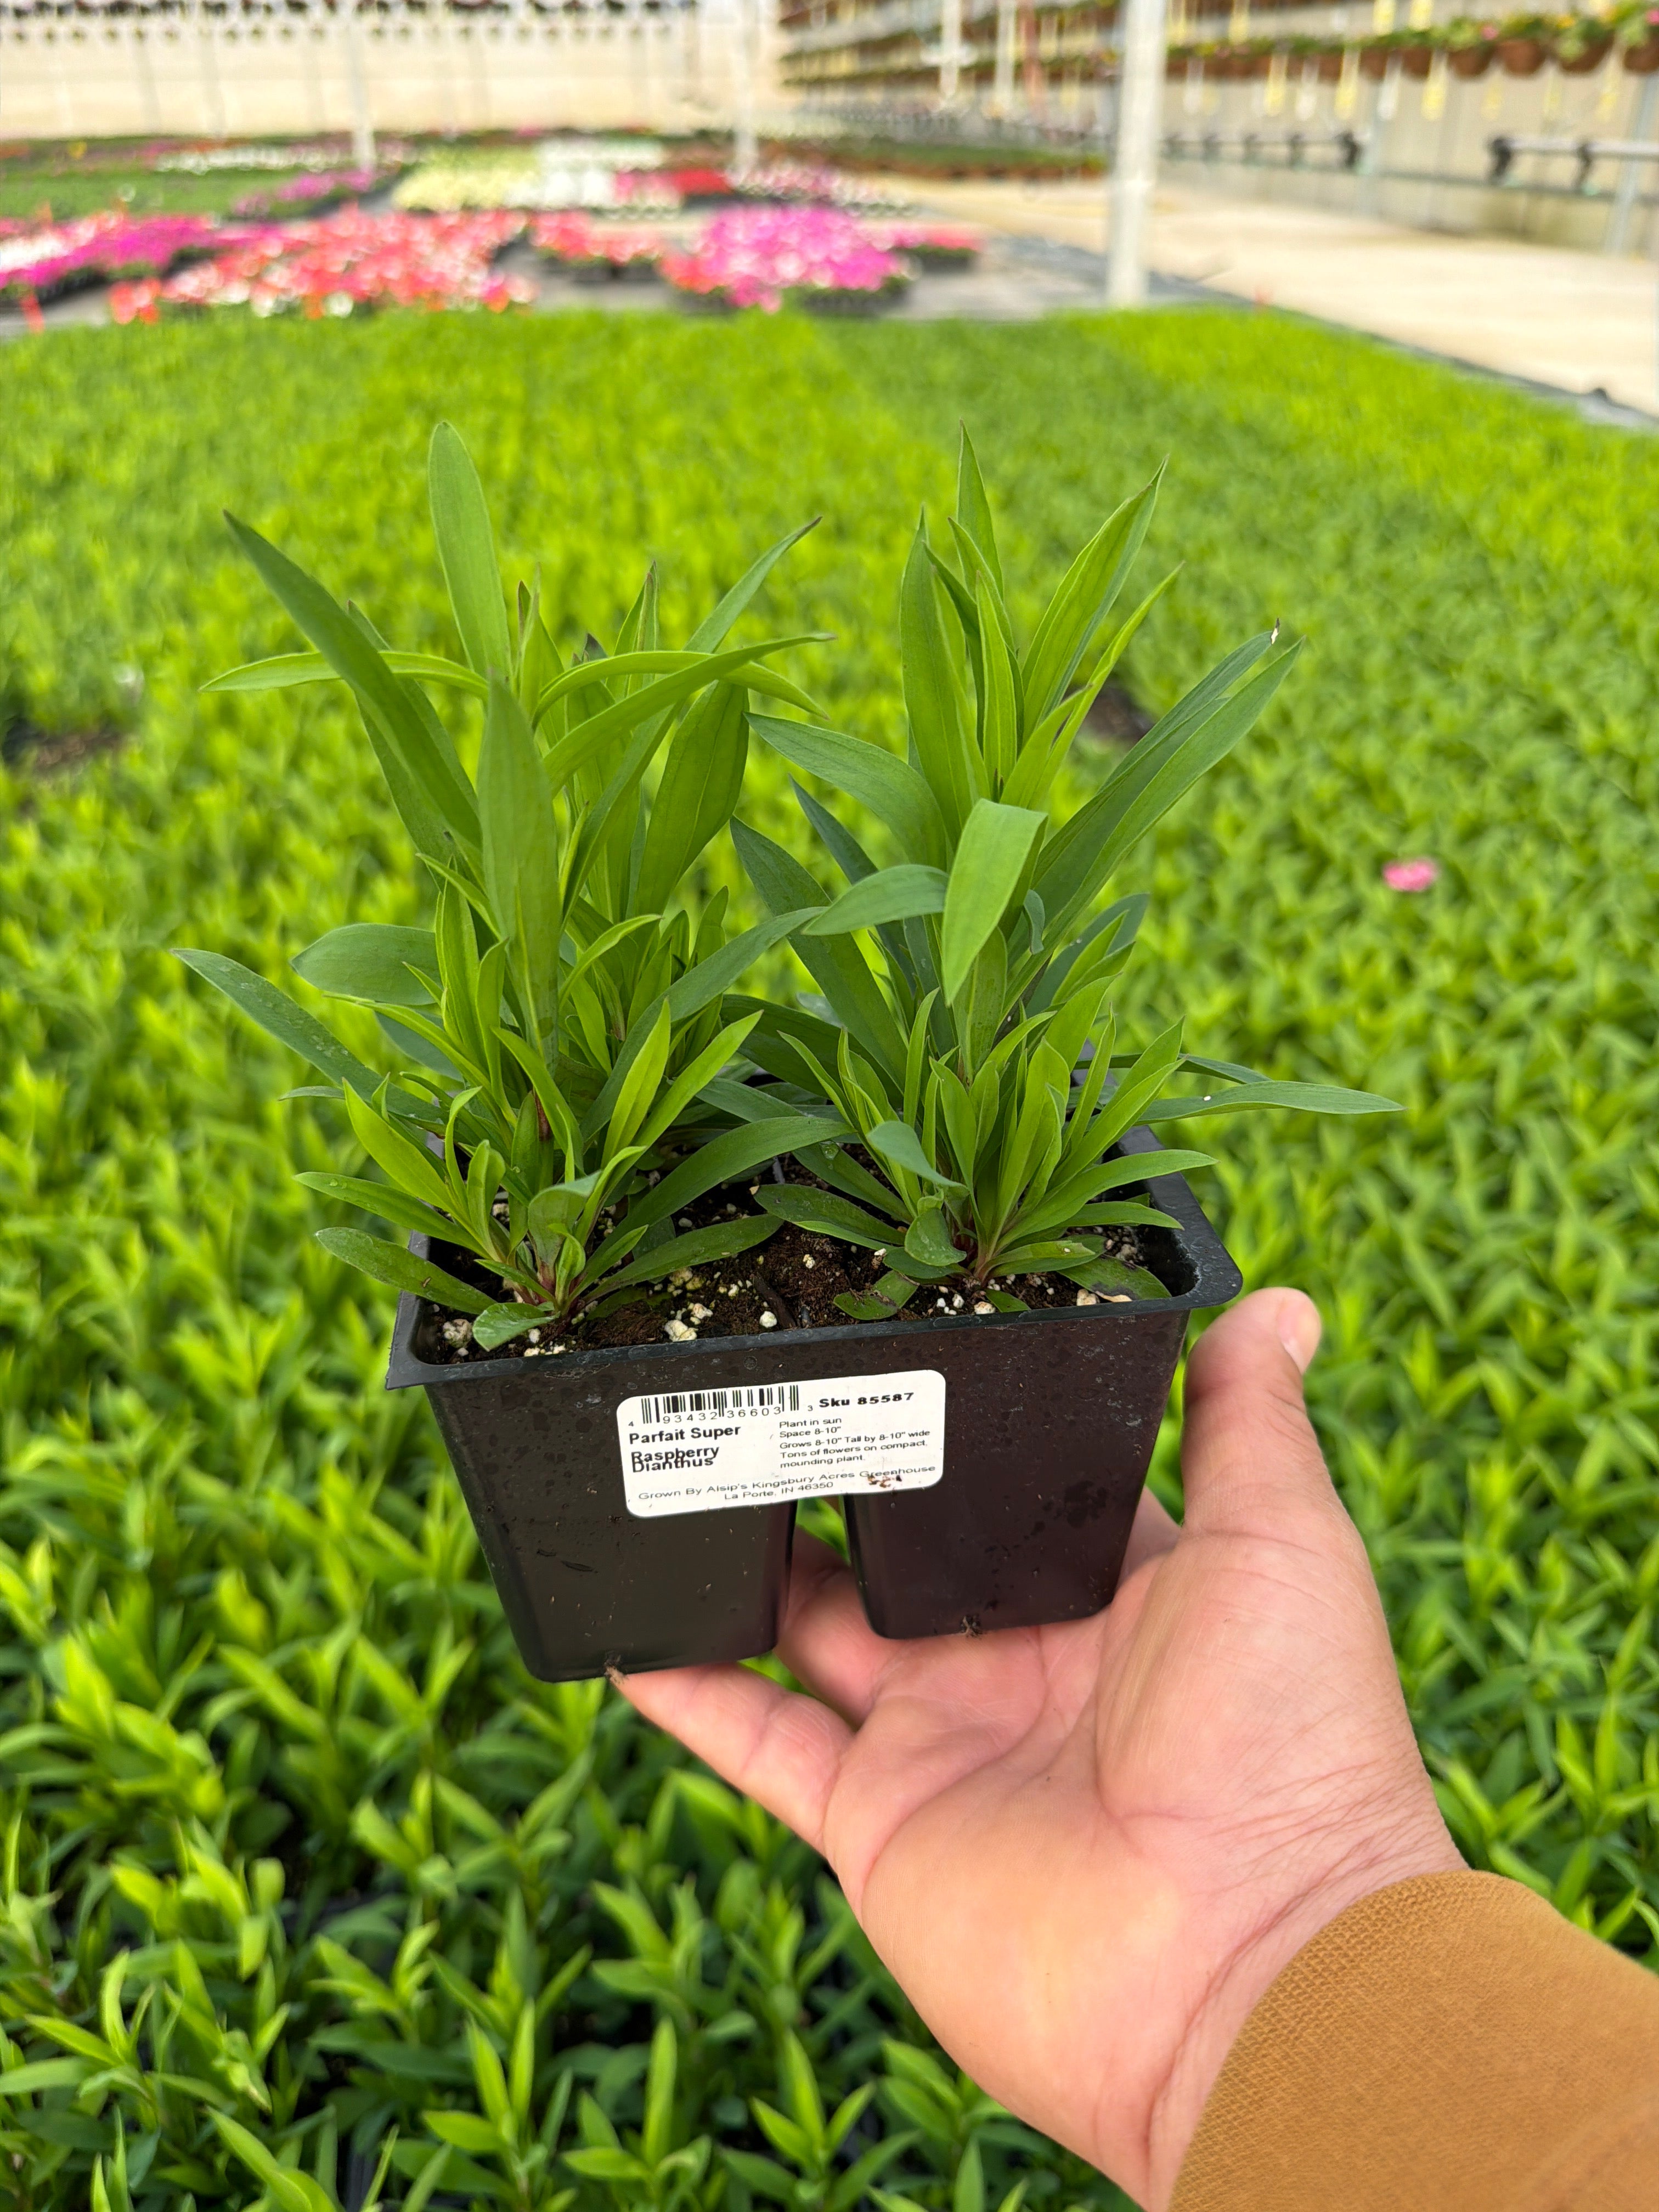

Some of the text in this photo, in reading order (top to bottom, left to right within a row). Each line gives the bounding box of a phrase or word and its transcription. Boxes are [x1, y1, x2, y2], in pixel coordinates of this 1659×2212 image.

[819, 1392, 914, 1408] Sku 85587
[779, 1420, 806, 1428] Plant
[629, 1426, 741, 1444] Parfait Super
[780, 1430, 811, 1438] Space
[780, 1441, 812, 1449] Grows
[815, 1437, 842, 1446] 8-10"
[865, 1435, 876, 1443] by
[879, 1432, 906, 1441] 8-10"
[631, 1446, 720, 1464] Raspberry
[823, 1446, 861, 1454] flowers
[632, 1456, 714, 1472] Dianthus
[780, 1455, 865, 1468] mounding plant.
[639, 1491, 680, 1499] Grown
[707, 1483, 748, 1493] Alsip's
[752, 1476, 814, 1488] Kingsbury
[819, 1472, 855, 1480] Acres
[860, 1465, 935, 1477] Greenhouse
[798, 1482, 833, 1491] 46350
